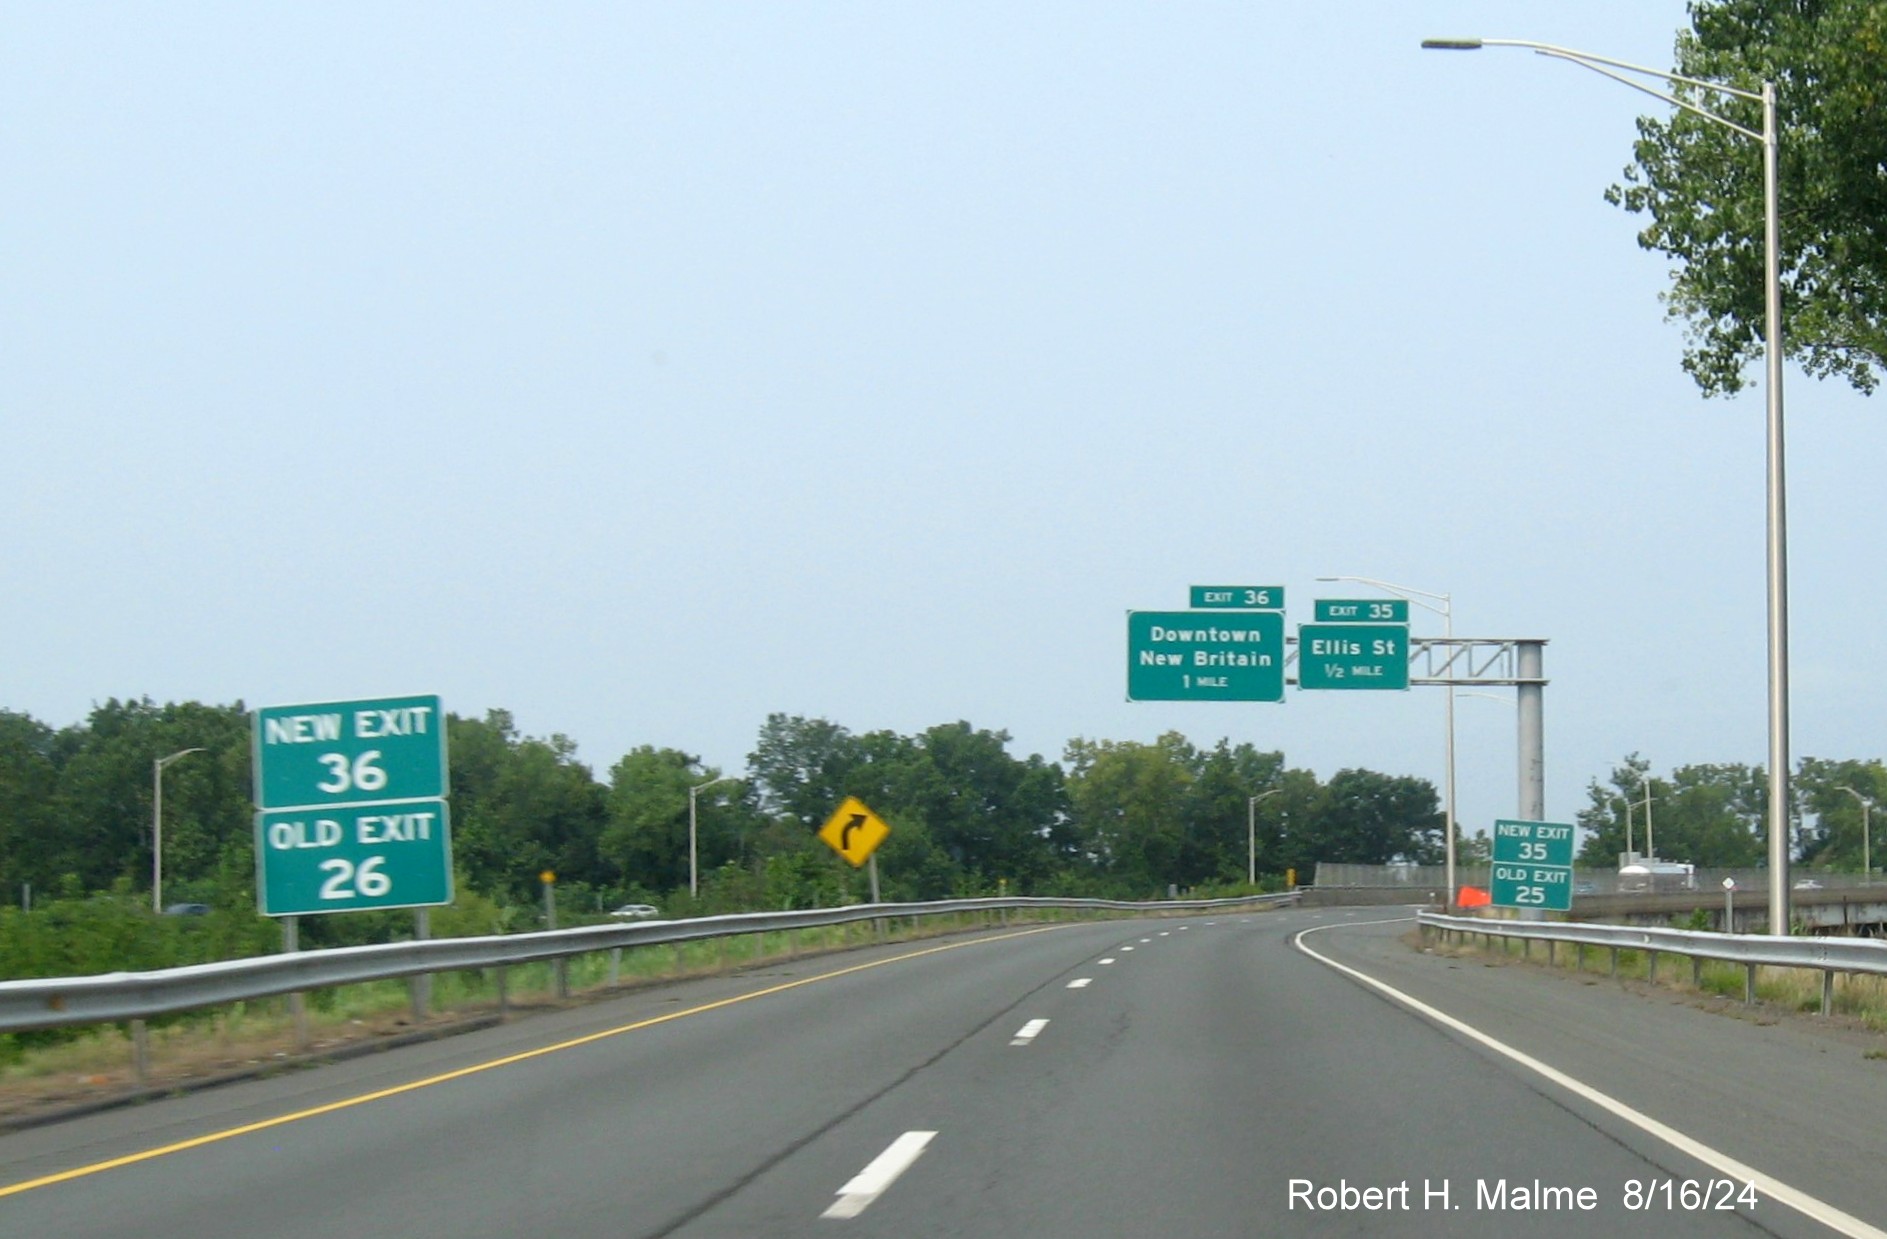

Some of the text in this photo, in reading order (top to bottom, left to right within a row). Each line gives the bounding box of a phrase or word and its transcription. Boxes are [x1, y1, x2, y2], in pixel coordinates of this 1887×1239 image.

[1204, 591, 1269, 604] EXIT 36
[1329, 605, 1393, 618] EXIT 35
[1151, 627, 1260, 642] Downtown
[1312, 640, 1395, 655] Ellis St
[1140, 651, 1271, 667] New Britain
[1353, 667, 1382, 676] MILE
[1183, 675, 1227, 688] 1 MILE
[265, 707, 431, 744] NEW EXIT
[317, 750, 387, 793] 36
[269, 813, 435, 850] OLD EXIT
[1498, 825, 1570, 839] NEW EXIT
[1518, 843, 1547, 860] 35
[319, 856, 391, 899] 26
[1496, 868, 1567, 883] OLD EXIT
[1515, 886, 1544, 903] 25
